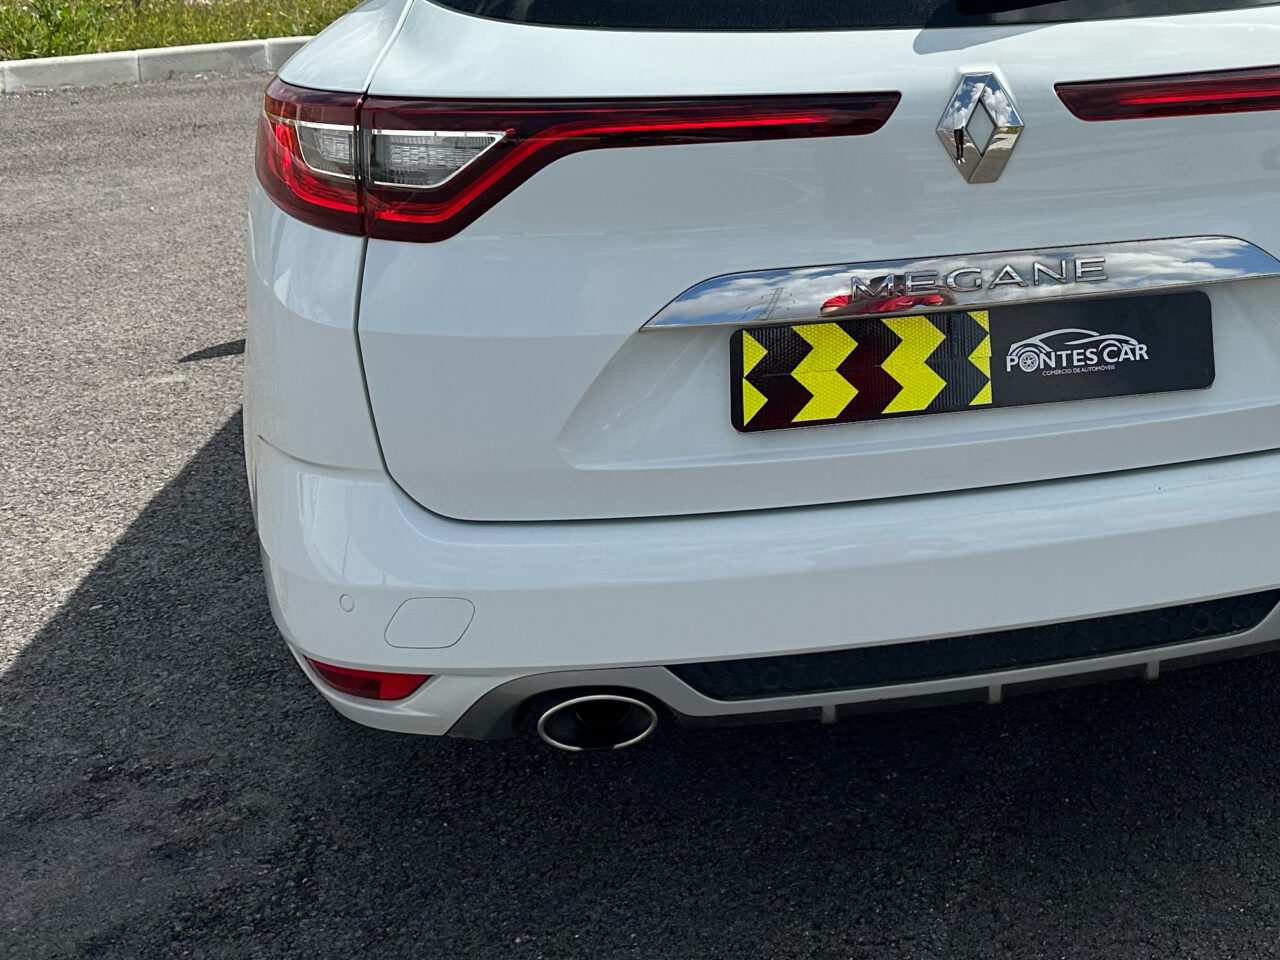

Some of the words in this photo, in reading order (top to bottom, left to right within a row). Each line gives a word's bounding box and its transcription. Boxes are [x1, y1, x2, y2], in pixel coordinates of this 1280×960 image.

[850, 257, 1108, 303] MEGANE
[1006, 348, 1098, 372] PONTES
[1102, 343, 1149, 363] CAR
